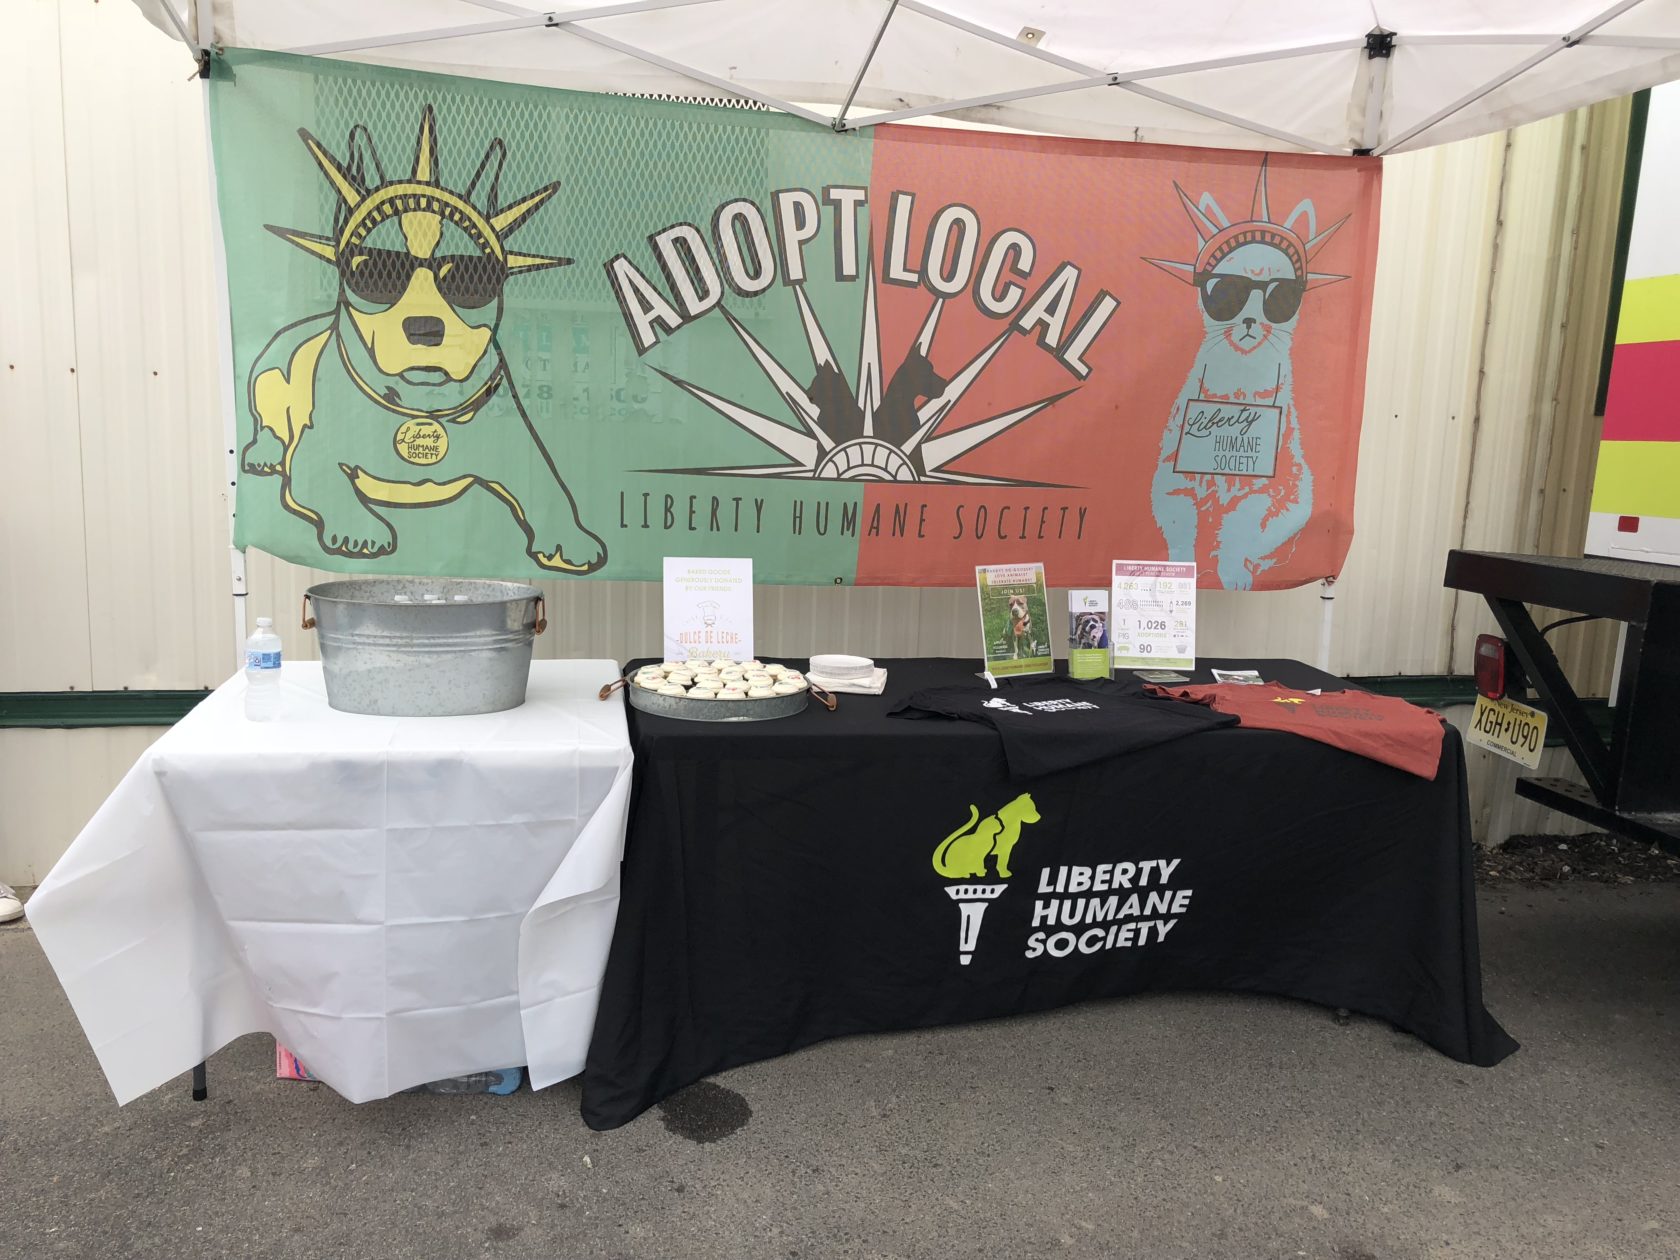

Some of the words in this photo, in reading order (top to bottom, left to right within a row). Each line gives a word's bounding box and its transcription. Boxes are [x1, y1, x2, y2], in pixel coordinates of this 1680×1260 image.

[603, 185, 868, 357] ADOPT
[882, 189, 1121, 382] LOCAL
[1185, 406, 1261, 438] Liberty
[397, 426, 444, 445] Liberty
[1213, 435, 1261, 453] HUMANE
[407, 443, 441, 452] HUMANE
[407, 451, 440, 460] SOCIETY
[1213, 454, 1259, 472] SOCIETY
[618, 491, 764, 534] LIBERTY
[791, 498, 928, 539] HUMANE
[952, 504, 1089, 540] SOCIETY
[1137, 619, 1167, 631] 1,026
[679, 631, 702, 644] DULCE
[705, 631, 713, 644] DE
[717, 631, 738, 644] LECHE
[1139, 643, 1153, 653] 90
[1509, 702, 1529, 718] Jersey
[1474, 704, 1505, 738] XGH
[1510, 718, 1539, 753] U90
[1486, 740, 1517, 758] COMMERCIAL
[1037, 858, 1181, 893] LIBERTY
[1031, 889, 1193, 927] HUMANE
[1025, 919, 1178, 959] SOCIETY
